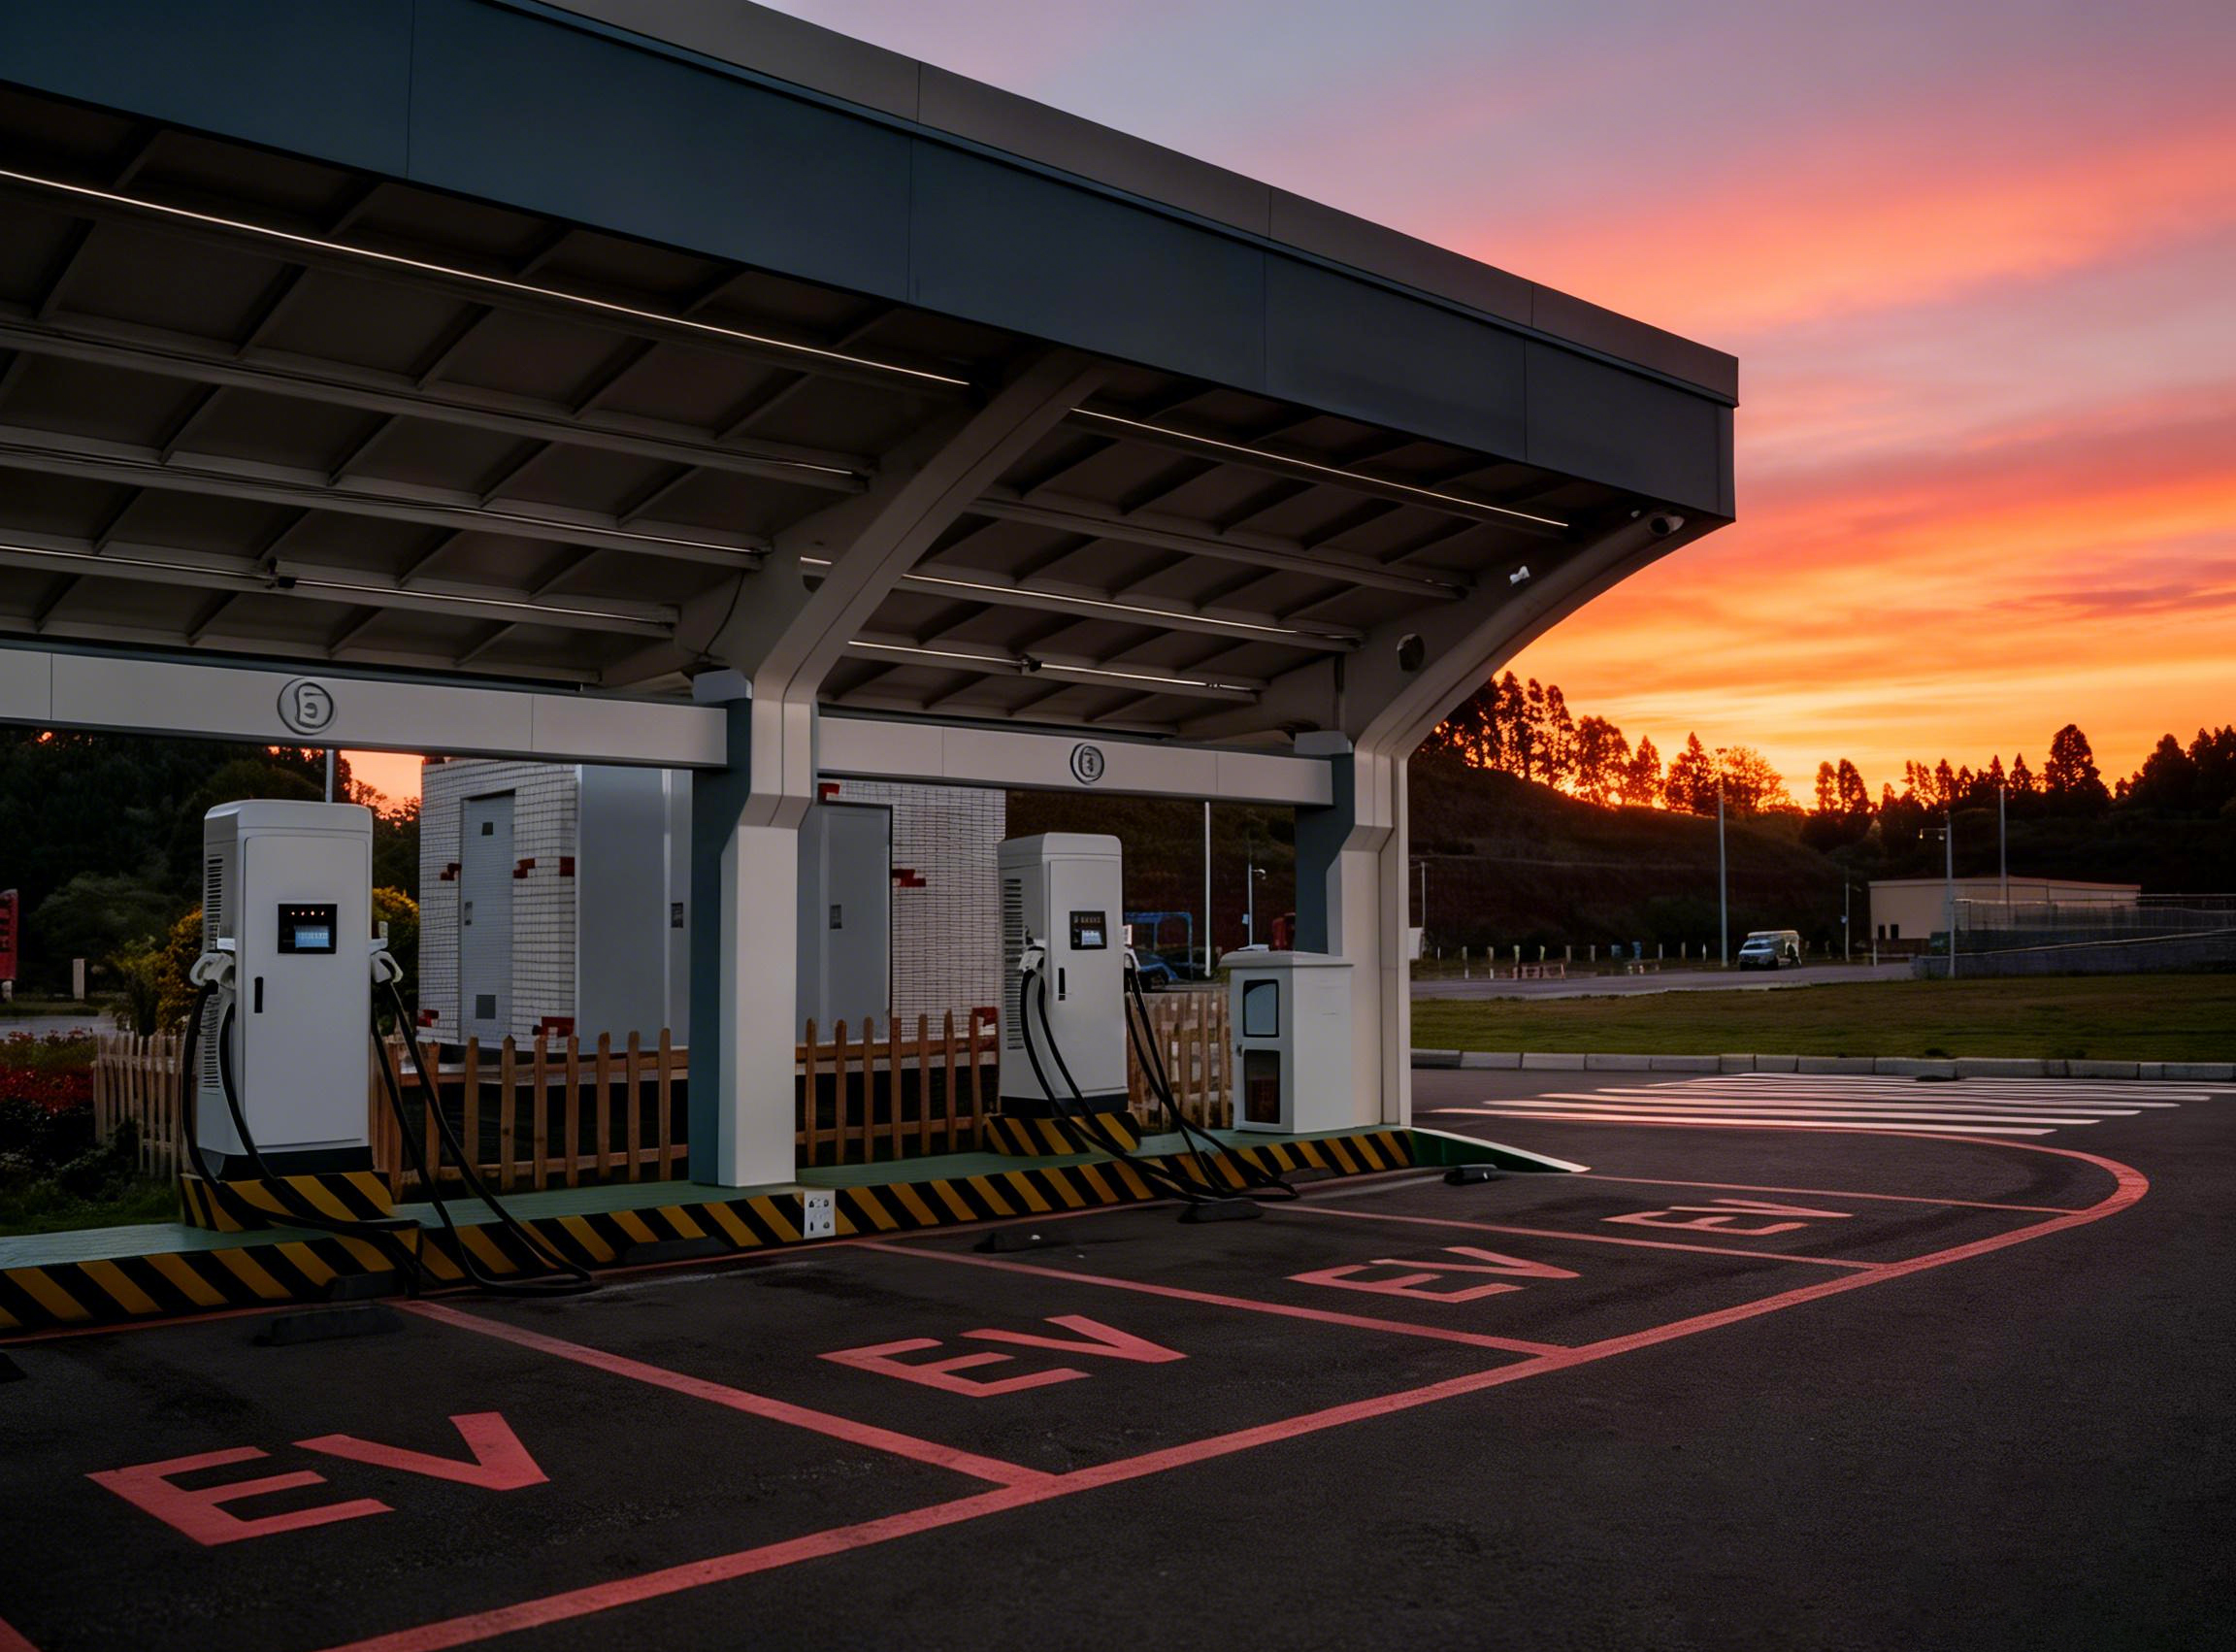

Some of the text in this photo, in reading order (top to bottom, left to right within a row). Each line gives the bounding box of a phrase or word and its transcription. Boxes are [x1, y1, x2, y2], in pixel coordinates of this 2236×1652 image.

[1601, 1199, 1854, 1237] EV
[1284, 1247, 1582, 1304] EV
[816, 1314, 1189, 1398] EV
[84, 1410, 550, 1547] EV
